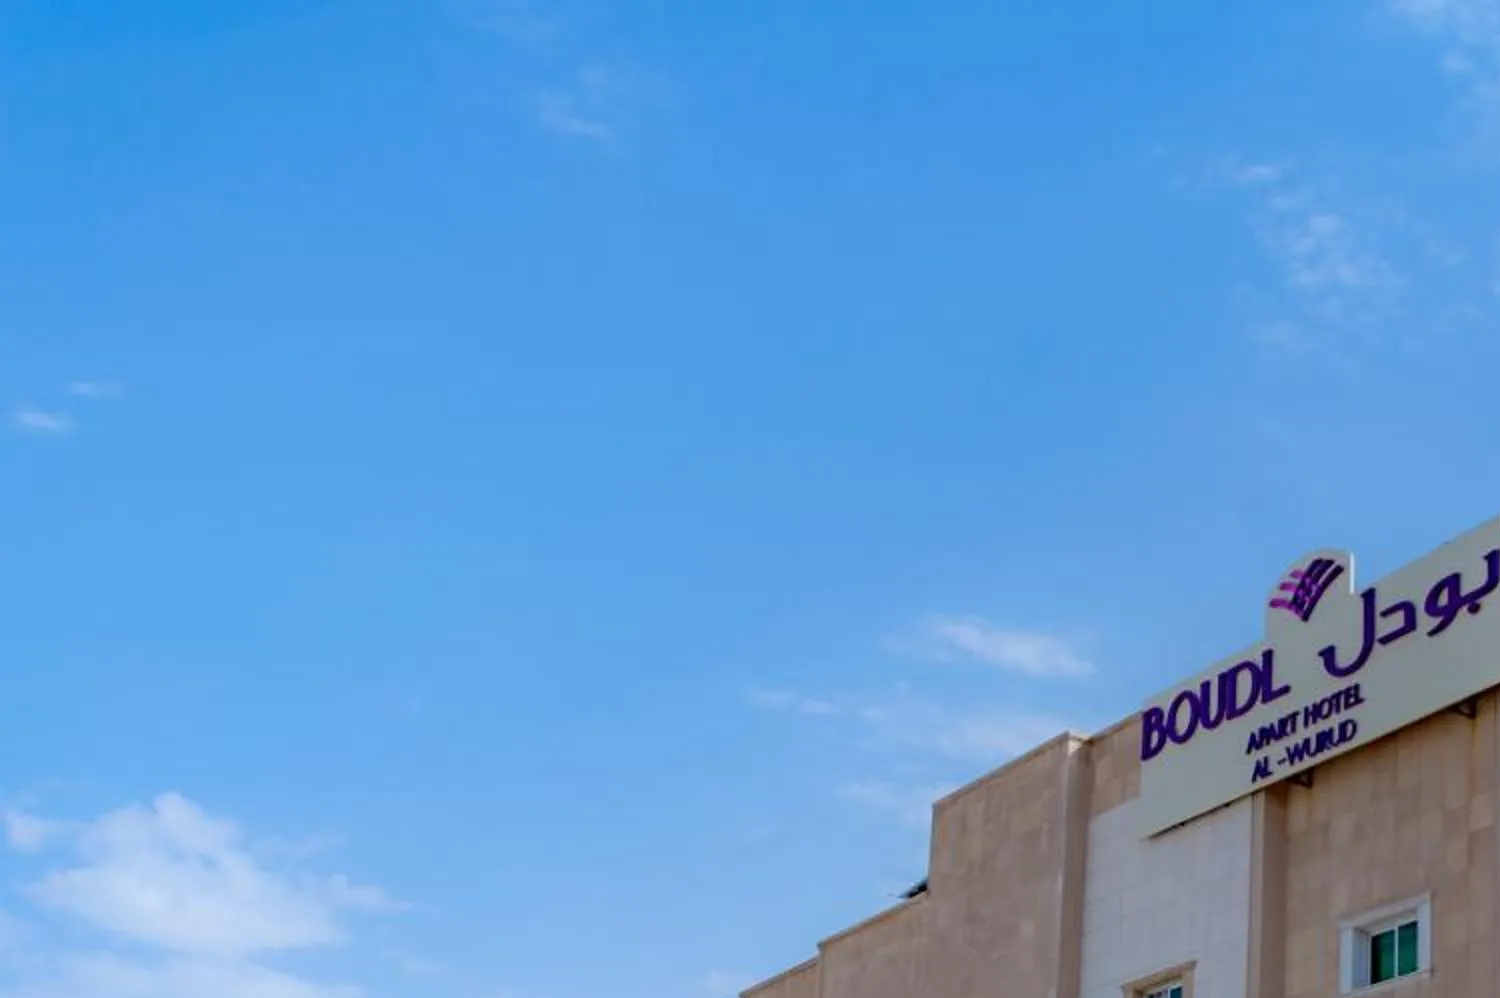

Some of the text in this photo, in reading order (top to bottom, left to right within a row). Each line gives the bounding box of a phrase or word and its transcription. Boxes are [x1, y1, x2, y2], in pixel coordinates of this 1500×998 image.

[1317, 547, 1500, 678] بودل
[1140, 649, 1291, 762] BOUDL
[1245, 683, 1366, 755] APART HOTEL
